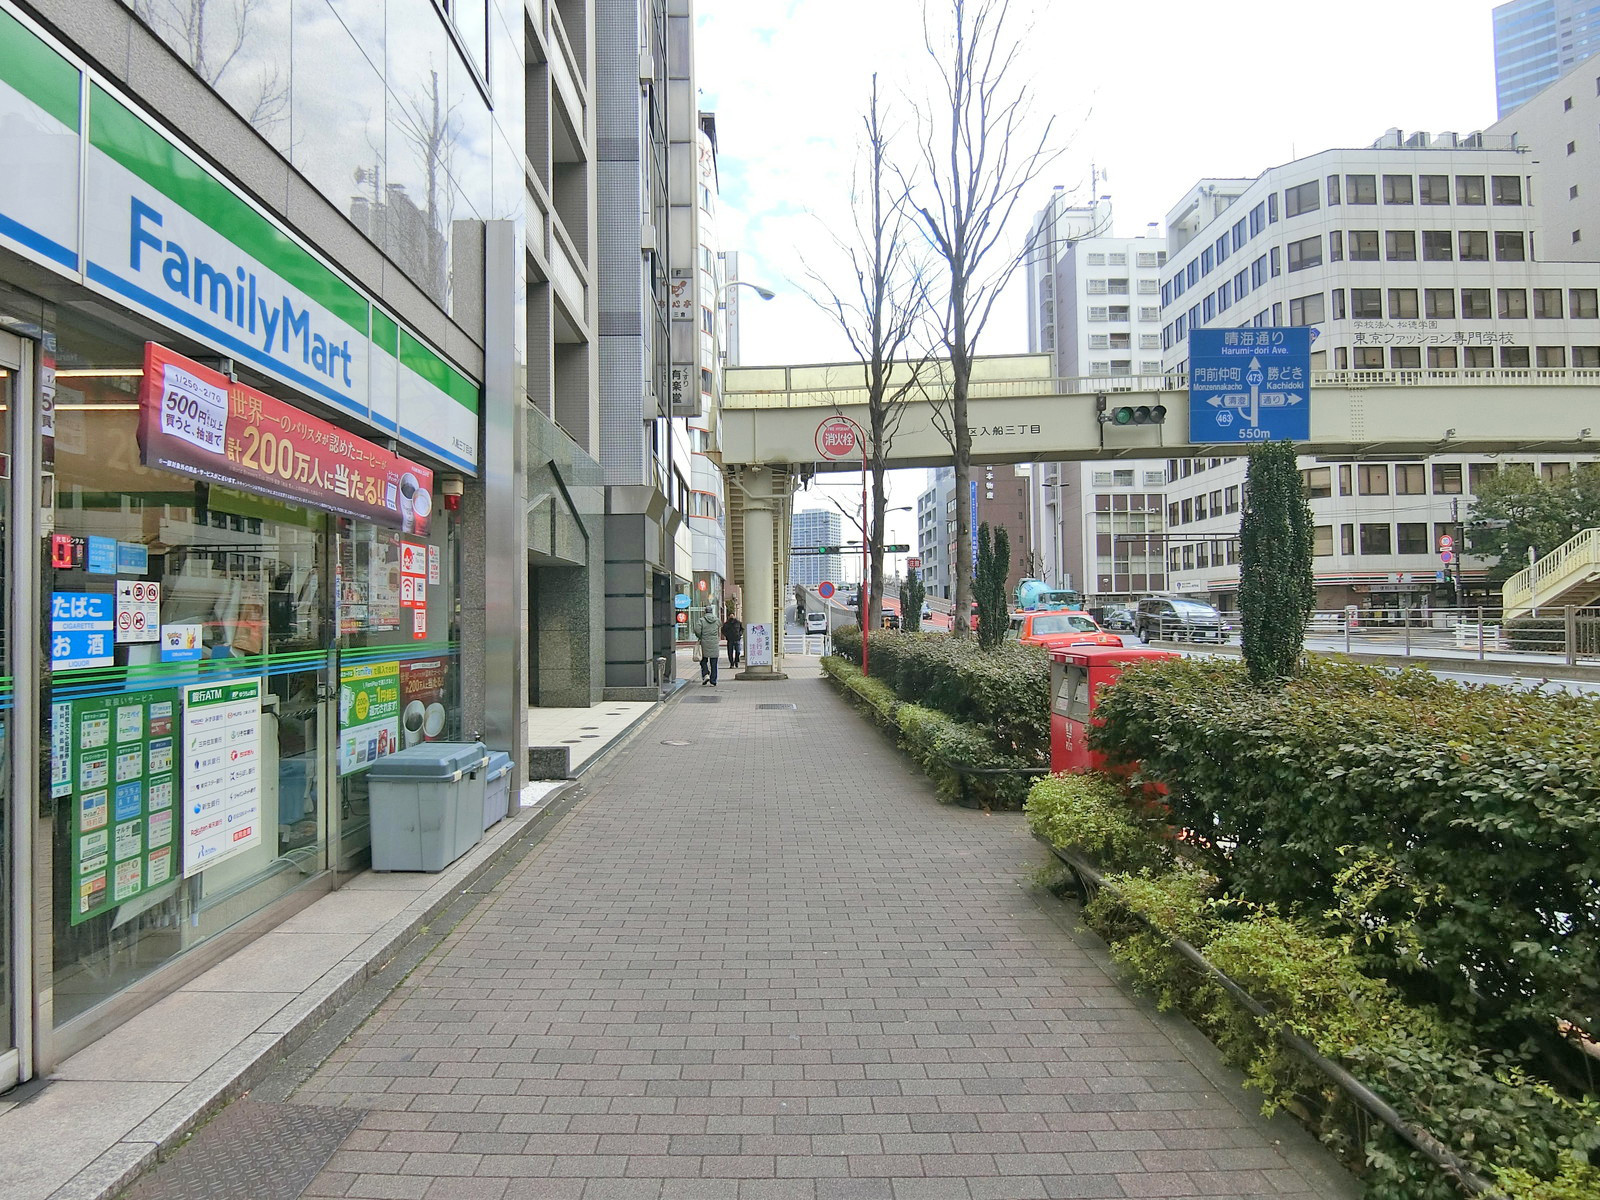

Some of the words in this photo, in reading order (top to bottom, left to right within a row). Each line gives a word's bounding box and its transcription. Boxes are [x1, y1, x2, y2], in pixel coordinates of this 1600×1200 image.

[130, 195, 352, 389] FamilyMart
[1353, 320, 1394, 329] 学校法人
[1224, 331, 1284, 346] 晴海通り
[1352, 331, 1515, 346] 東京ファッション専門学校
[1221, 346, 1269, 355] Harumi-dori
[1271, 346, 1289, 354] Ave.
[1194, 367, 1241, 382] 門前仲町
[1248, 374, 1261, 382] 473
[1267, 366, 1303, 380] 勝どき
[671, 369, 682, 404] 有楽堂
[1193, 383, 1243, 391] Monzennakacho
[1266, 381, 1304, 389] Kachidoki
[1263, 396, 1280, 404] 通り
[1217, 414, 1231, 423] 463
[165, 412, 223, 447] 買うと、抽選で
[230, 387, 388, 470] 世界一のバリスタが認めたコーヒーが
[941, 424, 1041, 438] 中区入船三丁目
[1238, 428, 1271, 439] 550m
[825, 432, 854, 446] 消火栓
[227, 425, 387, 507] 計200万人に当たる!!
[53, 596, 103, 618] たばこ
[62, 622, 95, 630] CIGARETTE
[53, 635, 71, 658] お
[87, 633, 105, 656] 酒
[68, 660, 90, 668] LIQUOR
[355, 665, 372, 676] FamiPay
[192, 688, 223, 703] 銀行ATM
[376, 686, 397, 703] 1円相当
